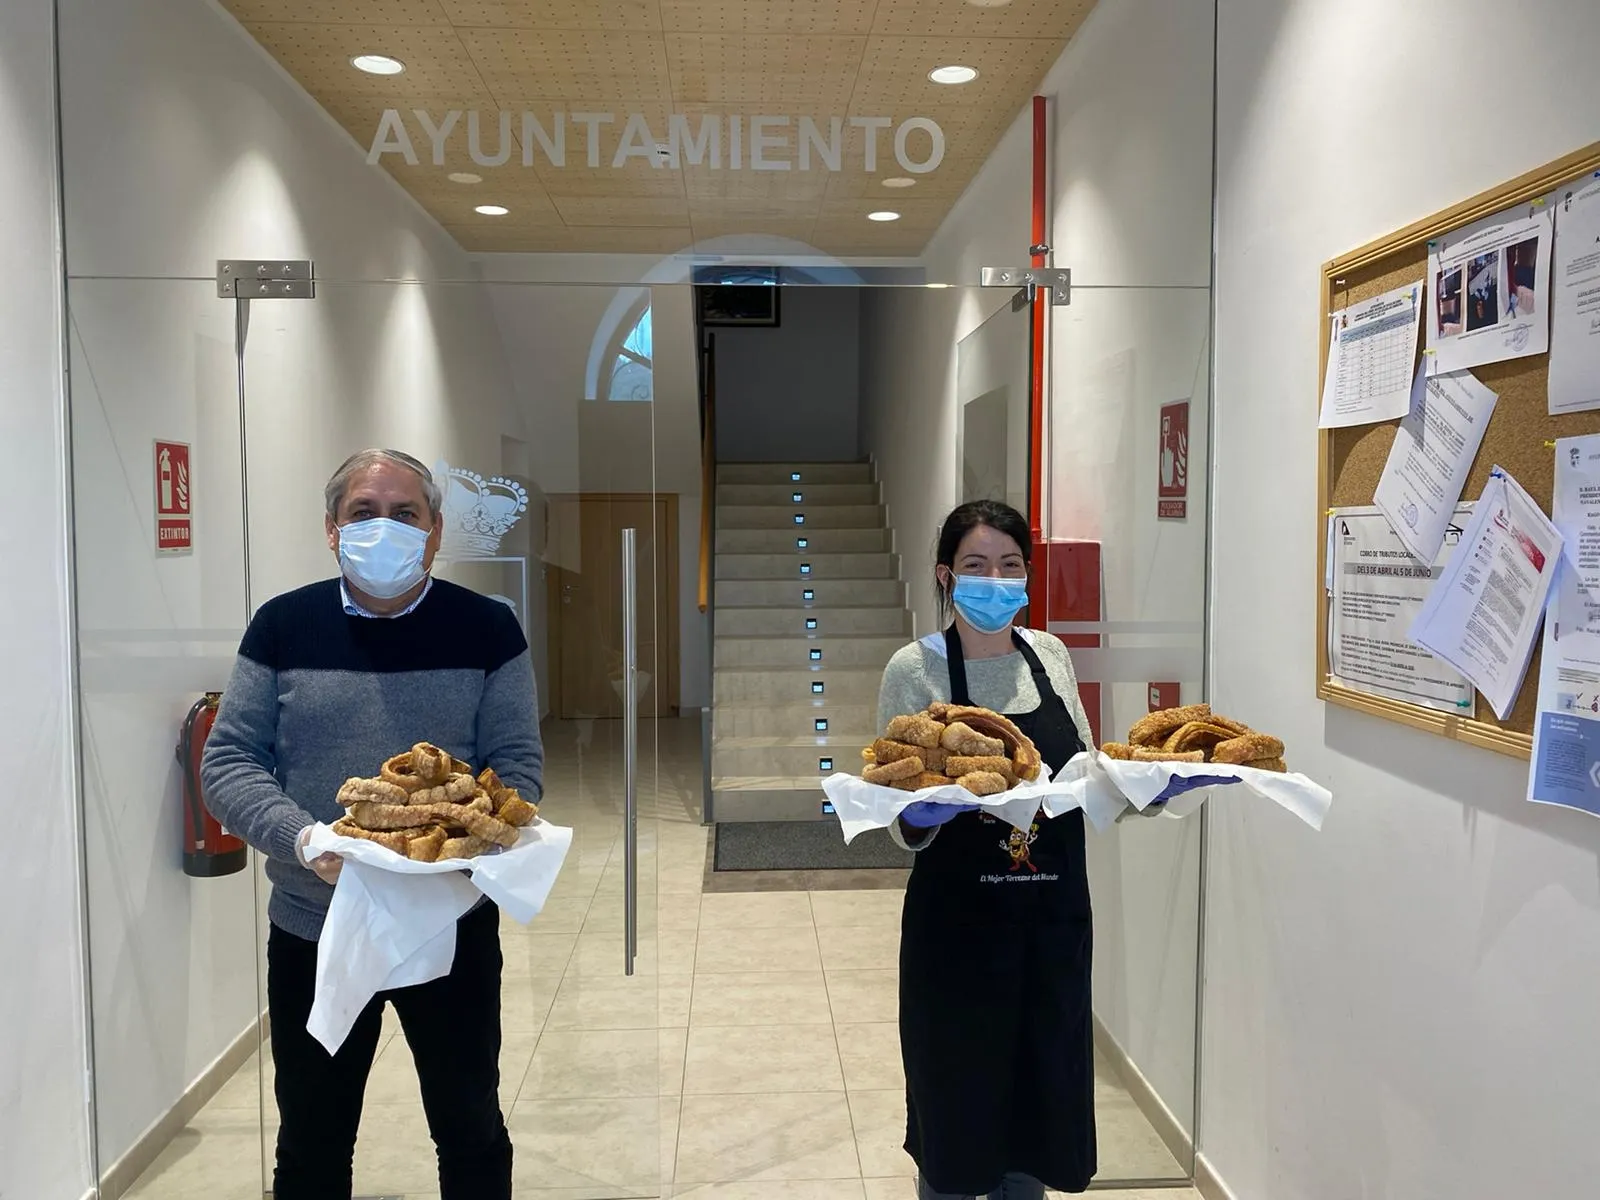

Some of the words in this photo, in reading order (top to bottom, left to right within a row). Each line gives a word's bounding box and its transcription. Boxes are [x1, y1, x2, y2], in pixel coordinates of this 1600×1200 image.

[365, 108, 946, 174] AYUNTAMIENTO
[160, 527, 189, 540] EXTINTOR
[1379, 550, 1398, 558] TRIBUTOS
[1370, 566, 1377, 575] DE
[1377, 566, 1392, 576] ABRIL
[1393, 567, 1400, 577] AL
[1404, 568, 1412, 577] DE
[1412, 568, 1432, 578] JUNIO
[987, 874, 1005, 883] Mejor
[1031, 873, 1041, 881] del
[1041, 873, 1059, 881] Mundo
